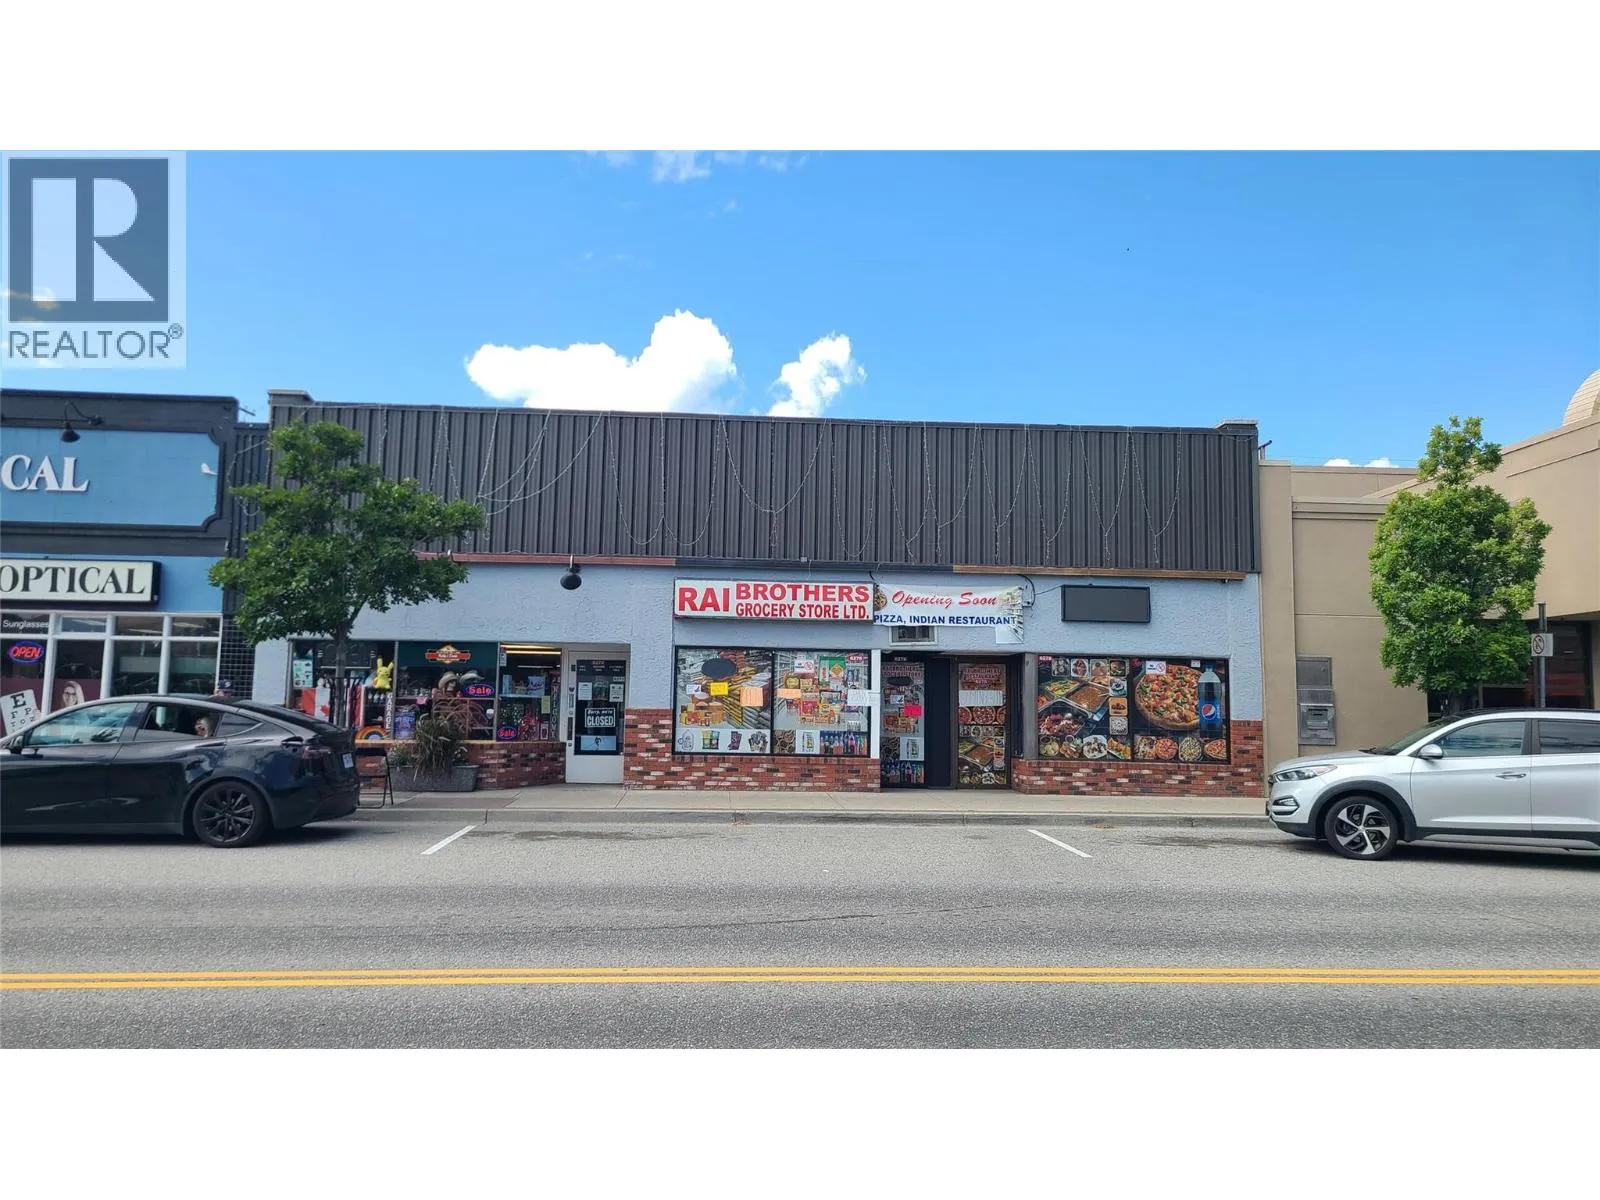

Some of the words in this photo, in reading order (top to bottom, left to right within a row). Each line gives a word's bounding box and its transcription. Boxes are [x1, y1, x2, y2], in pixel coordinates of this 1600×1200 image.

[1, 454, 90, 491] CAL
[0, 565, 145, 594] OPTICAL
[678, 587, 730, 612] RAI
[736, 583, 870, 603] BROTHERS
[892, 590, 953, 610] Opening
[959, 591, 998, 606] Soon
[736, 602, 795, 618] GROCERY
[799, 603, 839, 619] STORE
[844, 605, 869, 619] LTD.
[873, 614, 906, 624] PIZZA,
[909, 615, 945, 625] INDIAN
[949, 616, 1017, 625] RESTAURANT
[11, 645, 41, 658] OPEN
[469, 686, 492, 695] Sale
[10, 692, 26, 709] E
[587, 715, 613, 726] CLOSED
[500, 729, 515, 737] Sale
